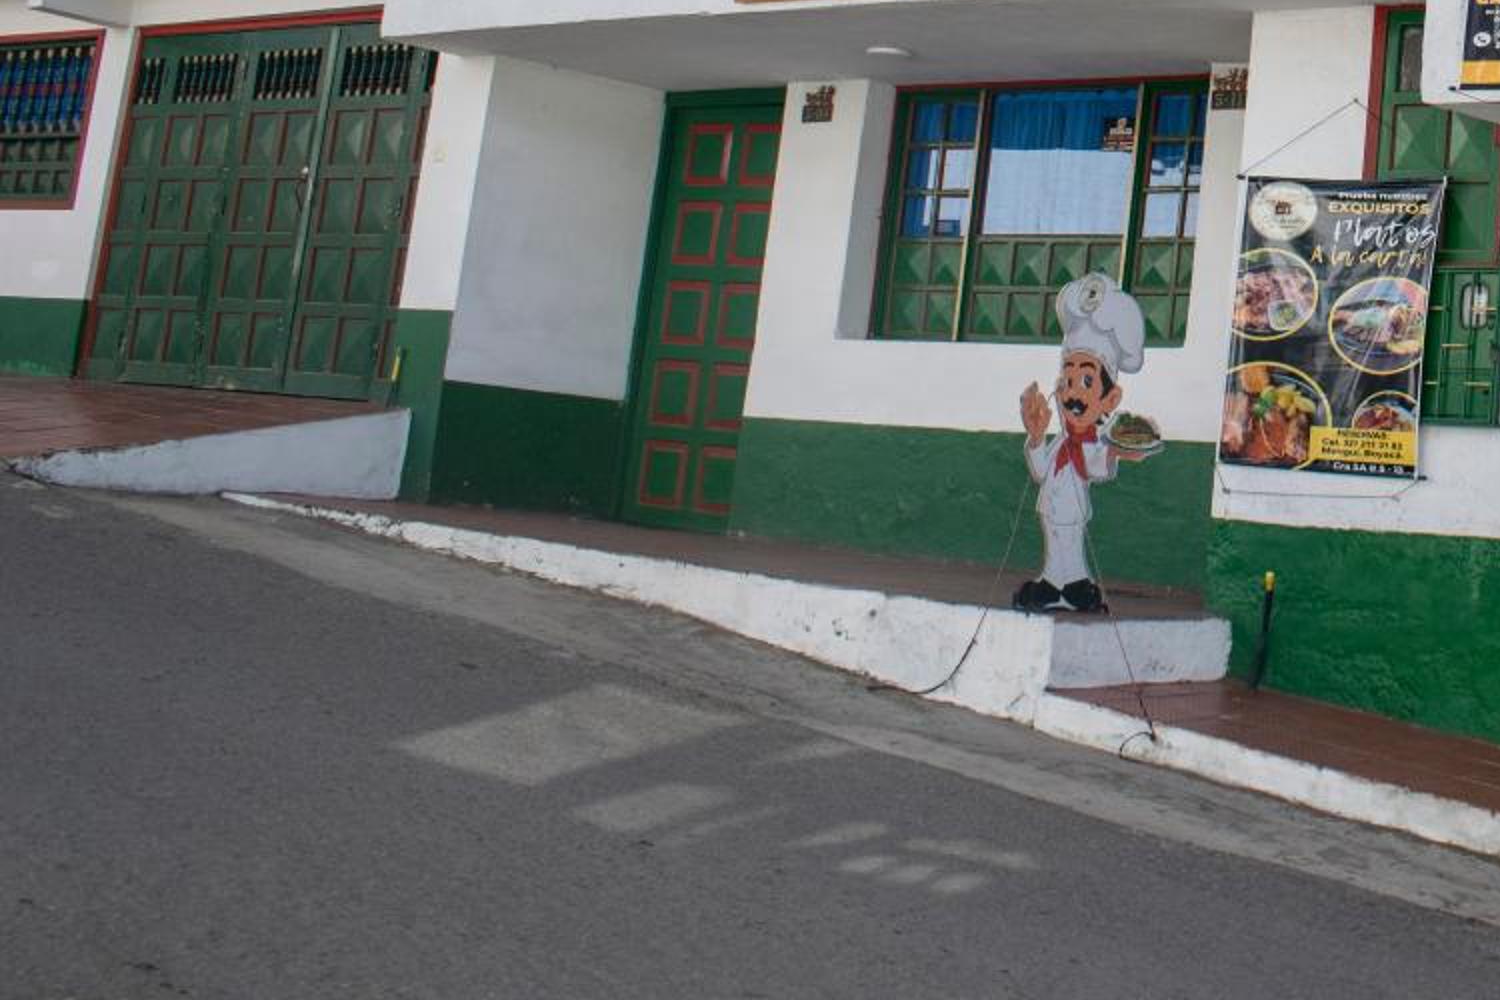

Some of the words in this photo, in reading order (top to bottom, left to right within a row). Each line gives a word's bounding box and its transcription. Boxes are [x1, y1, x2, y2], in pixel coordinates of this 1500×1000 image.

[1327, 200, 1434, 217] EXQUISITOS
[1334, 218, 1437, 249] Platos
[1311, 245, 1323, 264] A
